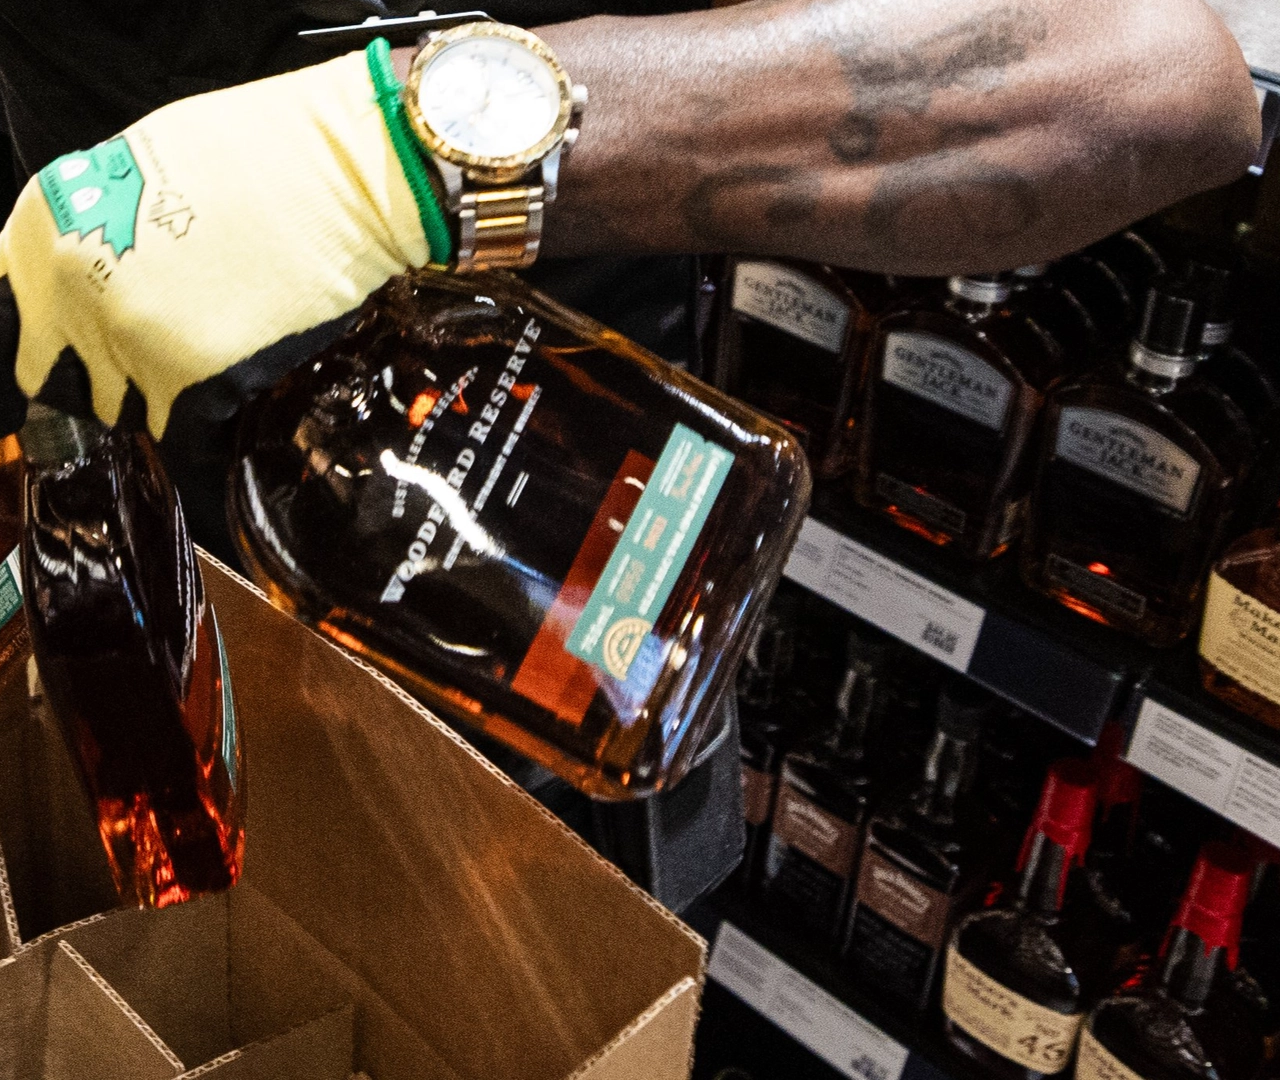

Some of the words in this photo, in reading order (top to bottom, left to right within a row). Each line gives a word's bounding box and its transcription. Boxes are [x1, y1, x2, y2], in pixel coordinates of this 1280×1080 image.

[431, 368, 476, 418] SELECT
[894, 346, 999, 399] GENTLEMAN
[380, 447, 476, 603] WOODFRD
[468, 317, 541, 445] RESERVE
[1069, 421, 1184, 480] GENTLEMAN
